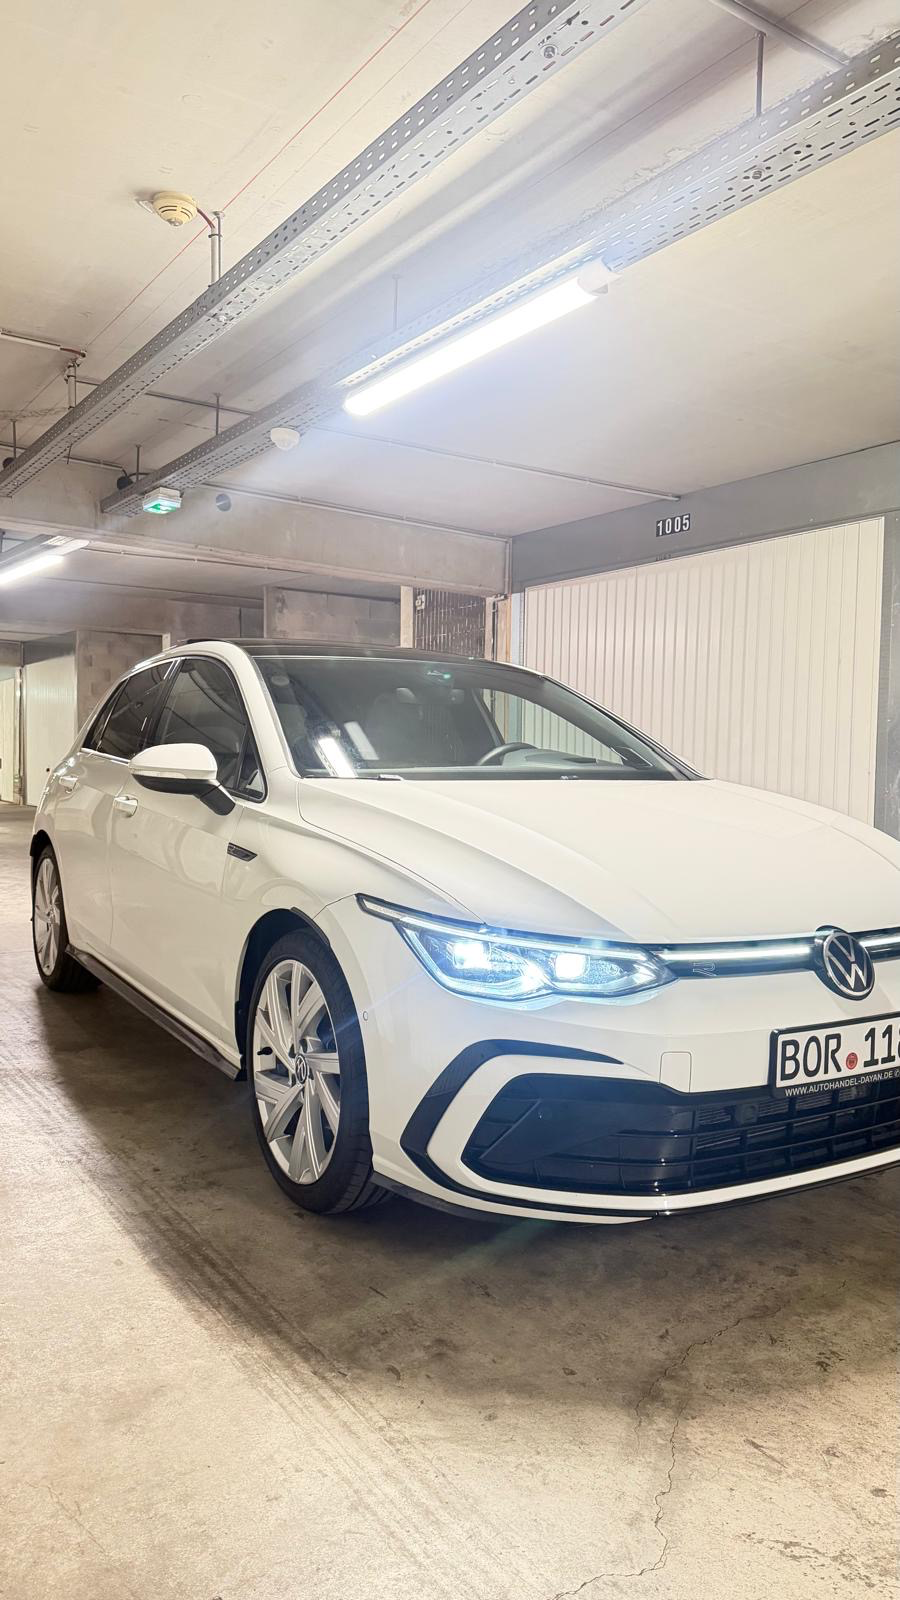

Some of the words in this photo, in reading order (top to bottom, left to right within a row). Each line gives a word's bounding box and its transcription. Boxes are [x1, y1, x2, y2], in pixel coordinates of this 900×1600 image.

[657, 514, 690, 536] 1005
[780, 1033, 842, 1082] BOR
[863, 1024, 900, 1067] 11
[785, 1070, 894, 1097] WWW.AUTOHANDEL-DAYAN.DE
